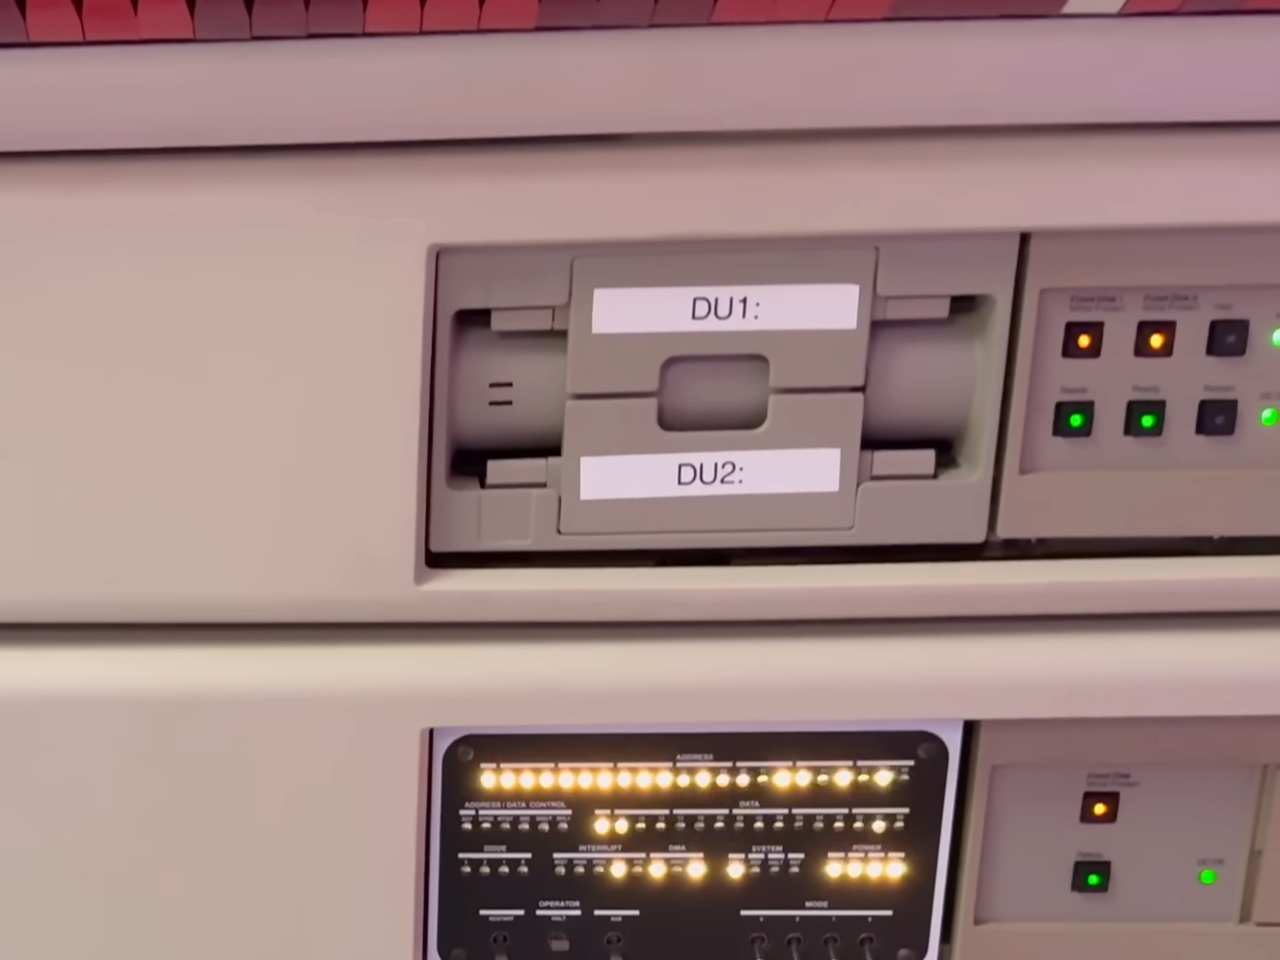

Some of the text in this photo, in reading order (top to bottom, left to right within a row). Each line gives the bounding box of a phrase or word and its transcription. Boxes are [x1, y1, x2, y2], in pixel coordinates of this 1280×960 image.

[692, 296, 760, 321] DU1:
[677, 462, 744, 486] DU2:
[675, 753, 714, 761] ADDRESS
[739, 800, 761, 808] DATA
[578, 844, 623, 852] INTERRUPT
[805, 900, 829, 908] MODE
